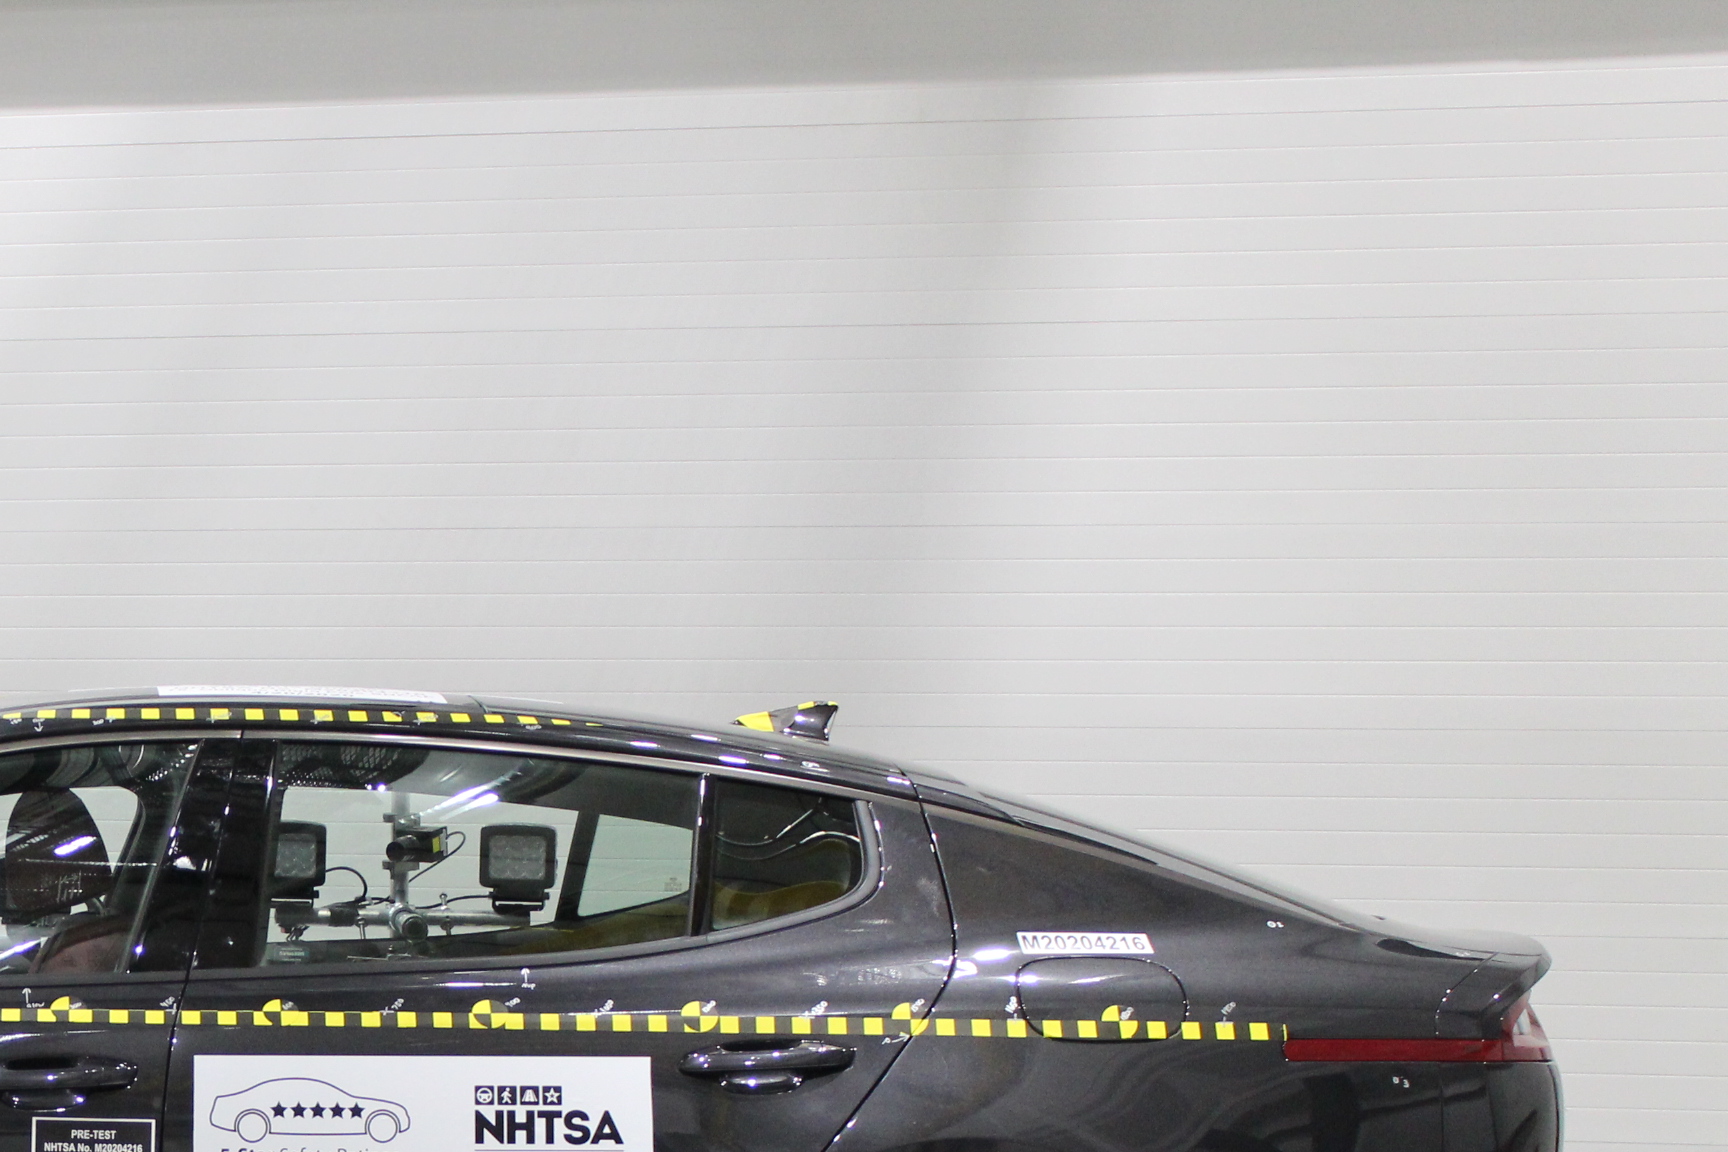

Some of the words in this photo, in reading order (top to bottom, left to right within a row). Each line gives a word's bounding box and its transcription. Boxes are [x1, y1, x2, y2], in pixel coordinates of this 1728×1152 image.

[1021, 935, 1147, 951] M20204216
[474, 1109, 625, 1146] NHTSA
[71, 1129, 116, 1140] PRE-TEST
[43, 1142, 76, 1152] NHTSA
[77, 1143, 92, 1152] No.
